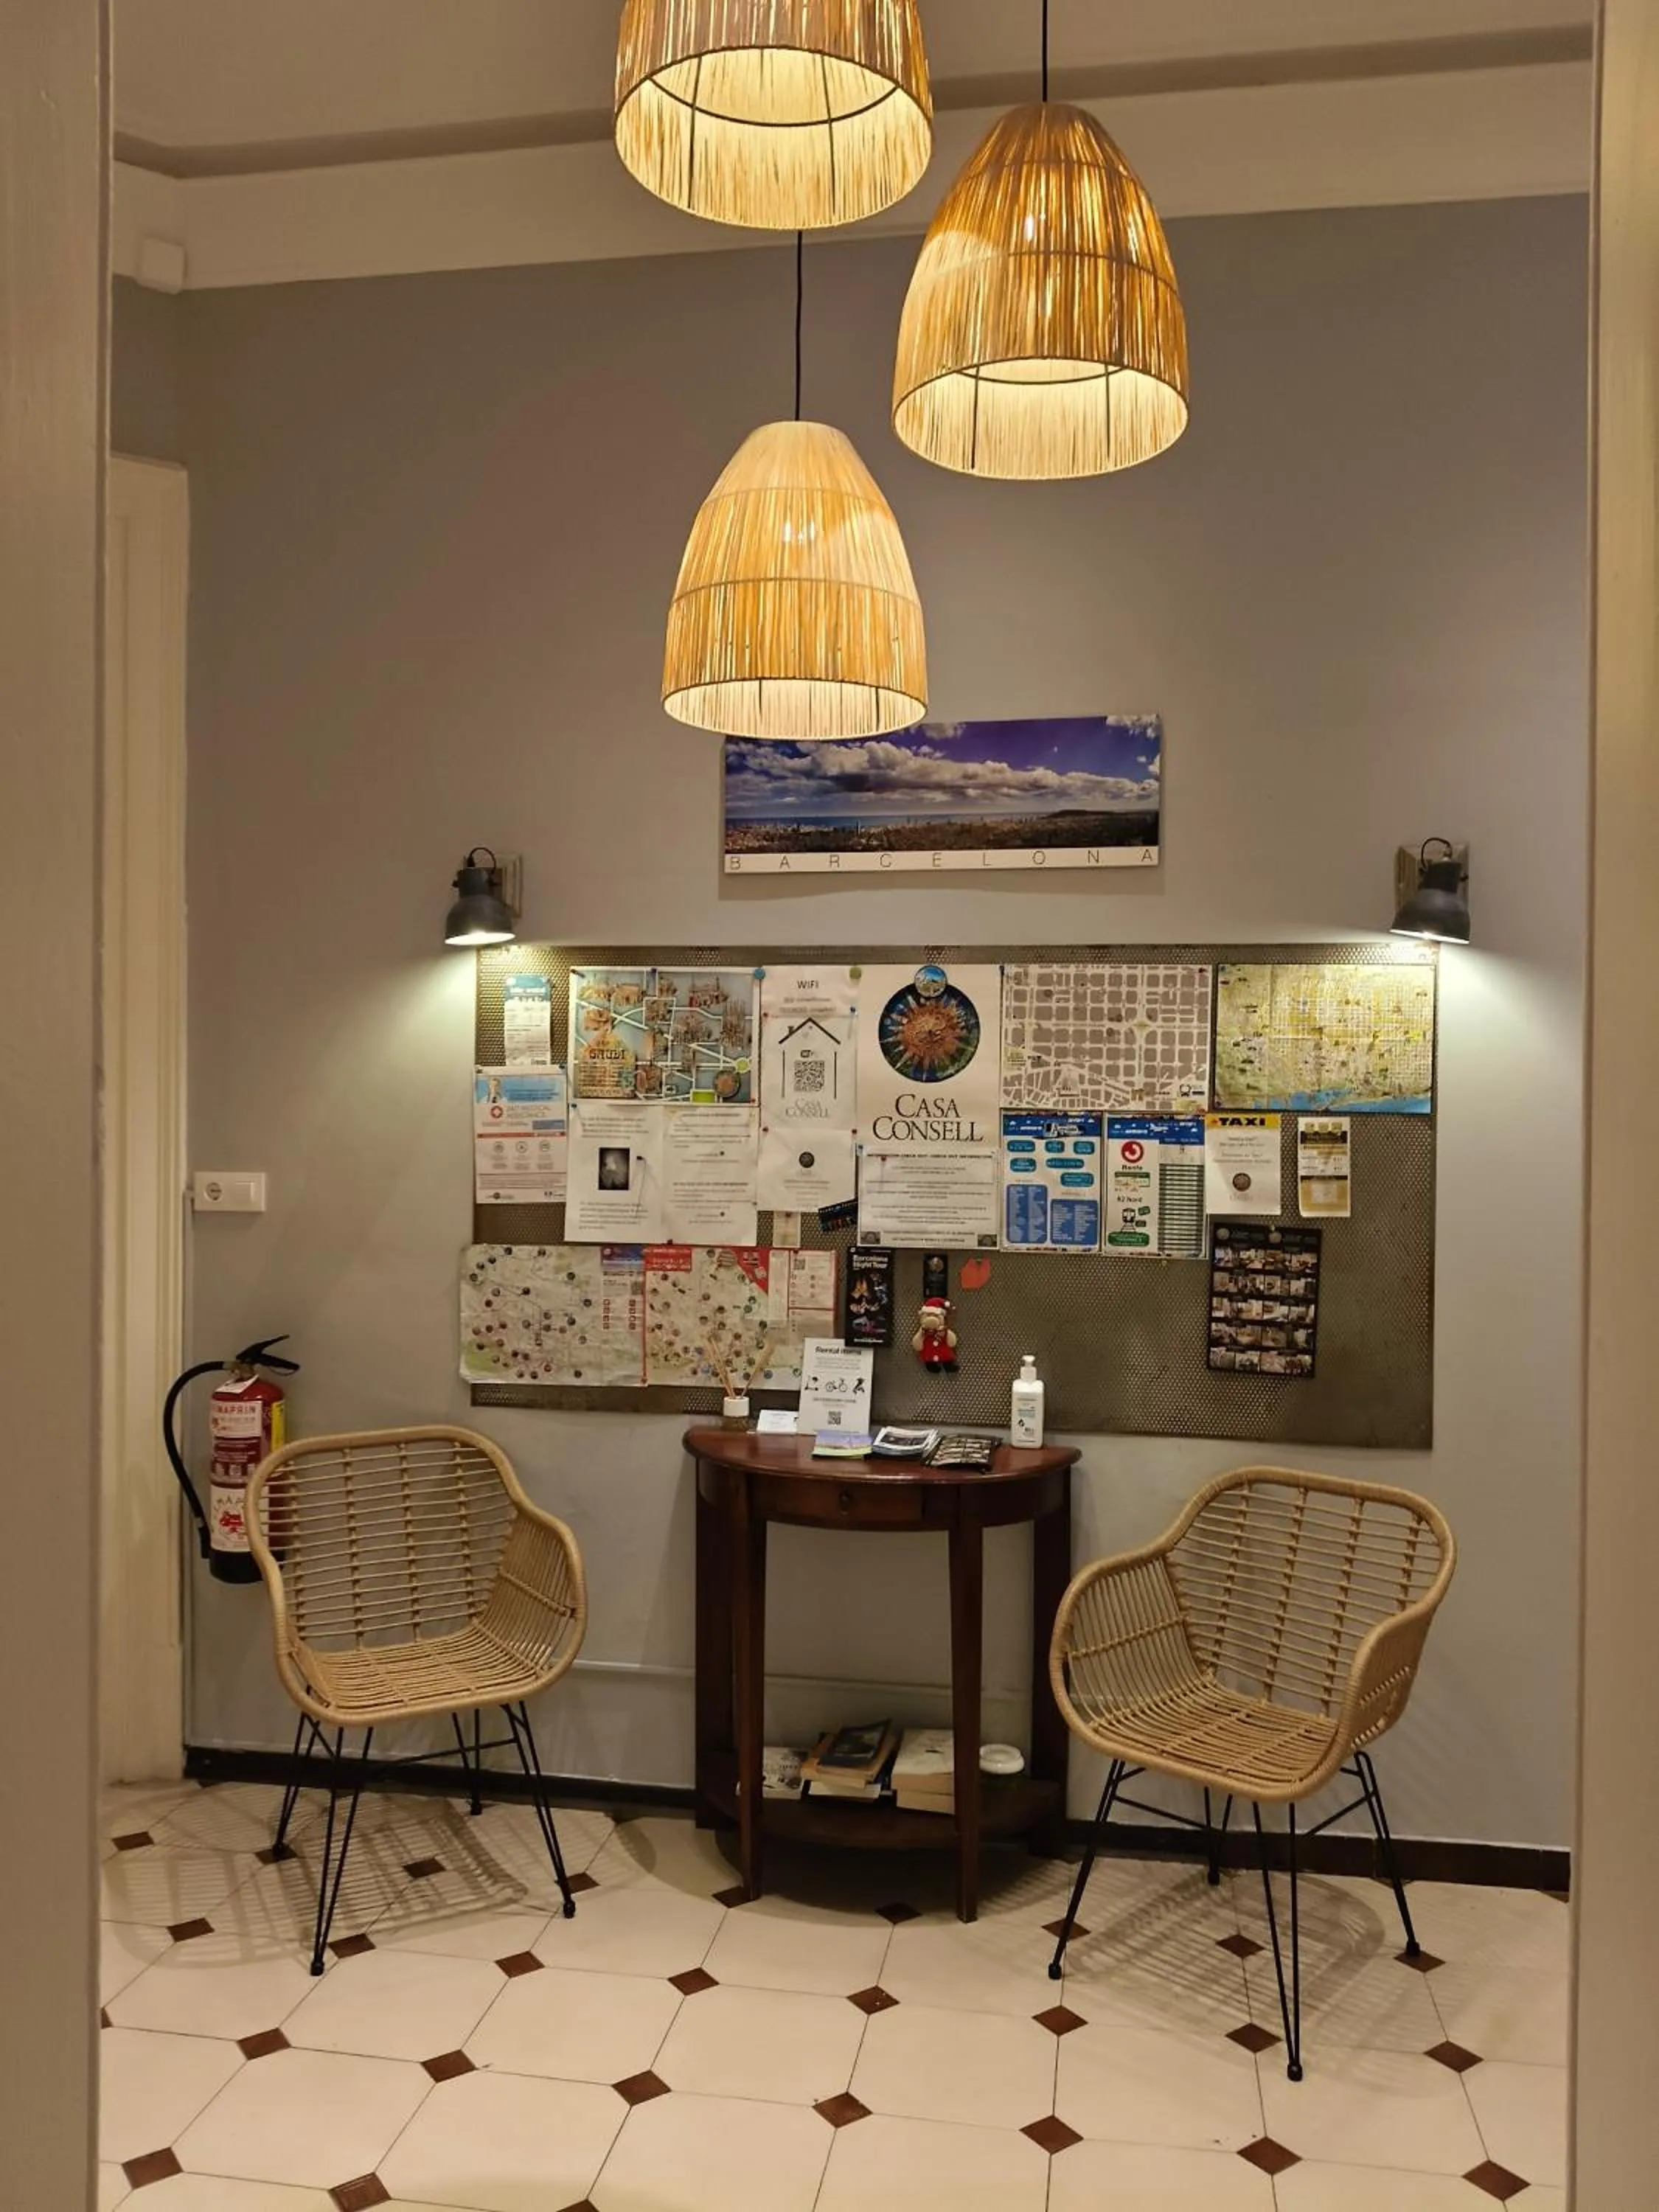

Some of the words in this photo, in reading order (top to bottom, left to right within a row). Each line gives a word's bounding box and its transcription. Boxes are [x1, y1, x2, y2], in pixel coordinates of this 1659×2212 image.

[728, 848, 1153, 870] BARCELONA
[796, 980, 819, 990] WIFI
[894, 1093, 961, 1119] CASA
[872, 1116, 984, 1142] CONSELL
[1219, 1117, 1265, 1127] TAXI
